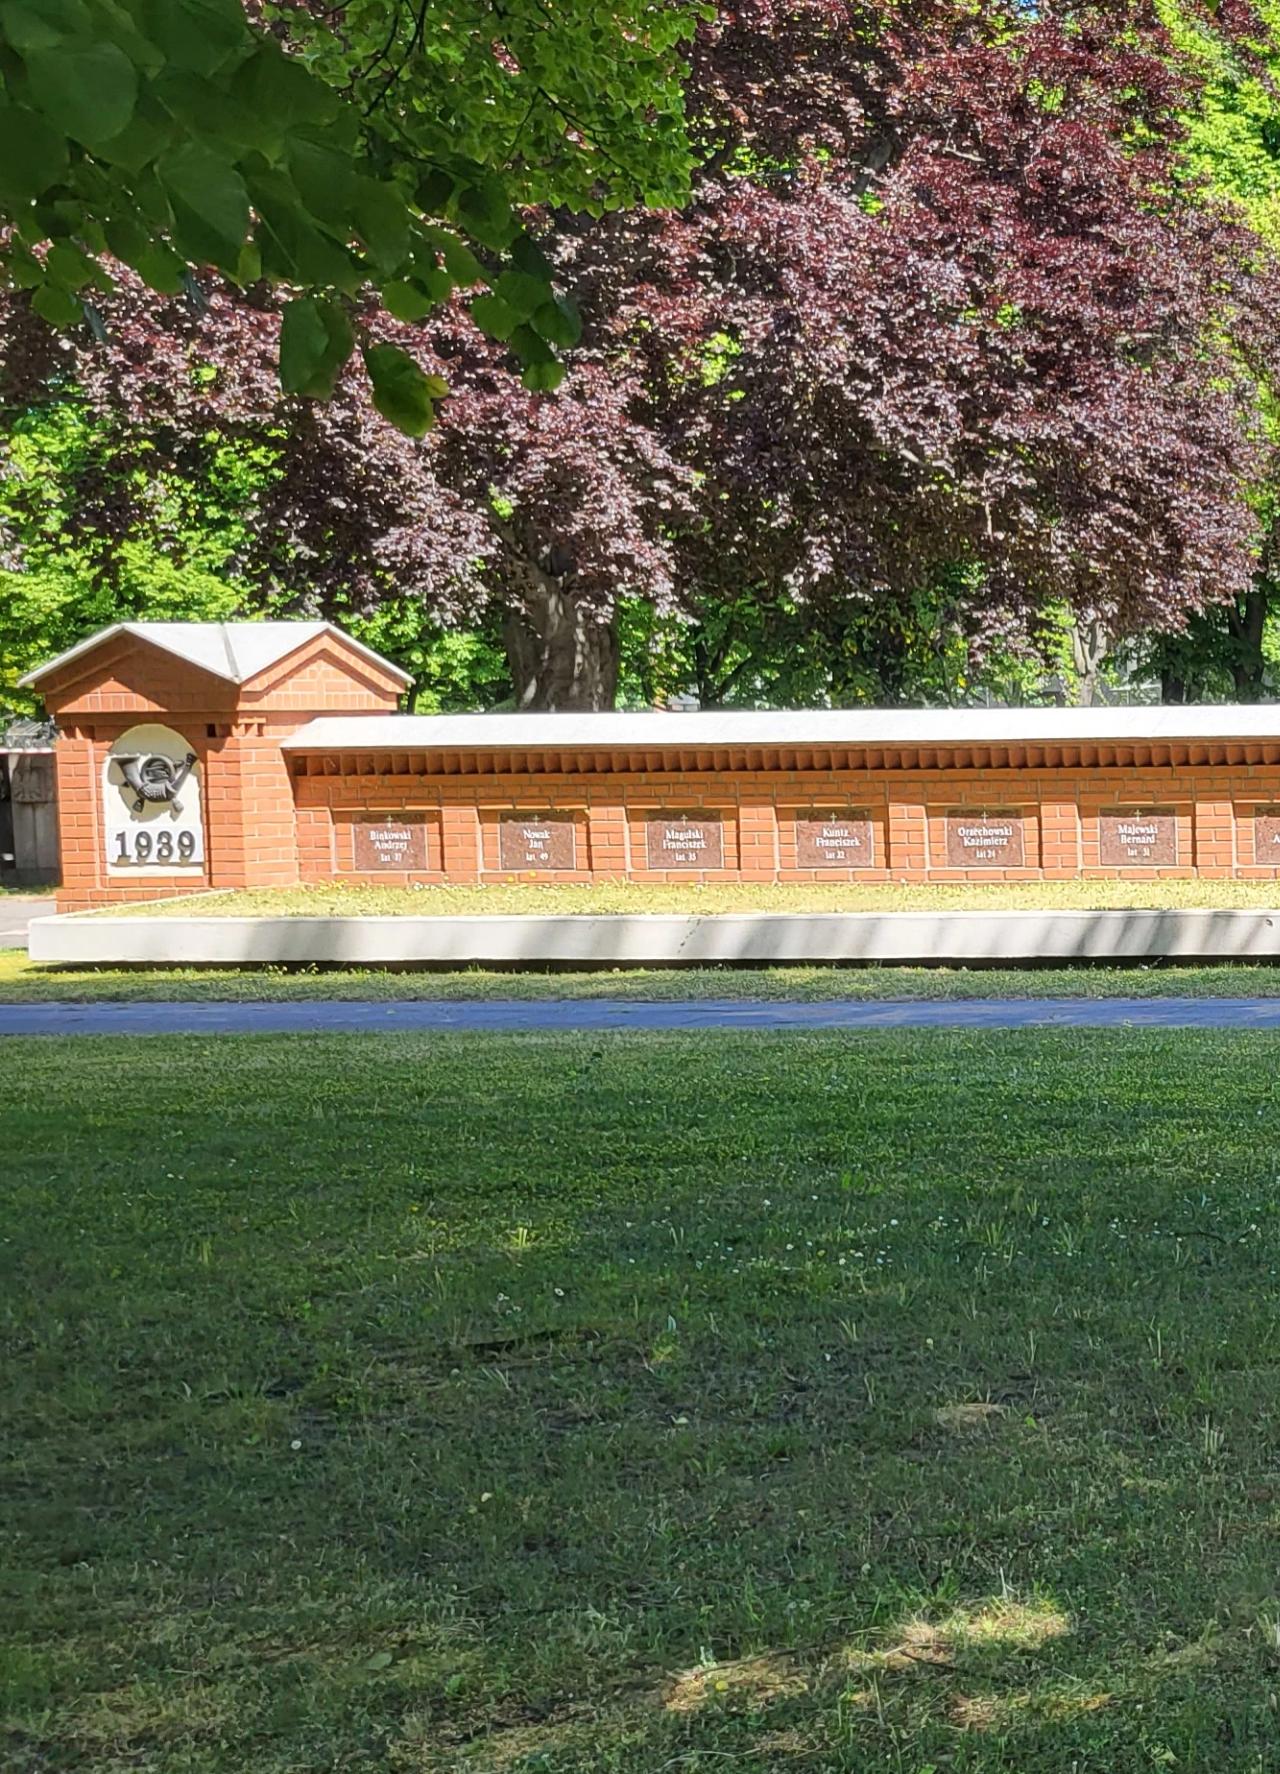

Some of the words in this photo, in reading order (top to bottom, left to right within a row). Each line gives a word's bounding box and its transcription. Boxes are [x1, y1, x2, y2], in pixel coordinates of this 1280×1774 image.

[523, 829, 551, 839] Nowak
[958, 826, 1012, 836] Orzechowski
[1118, 824, 1158, 835] Majewski
[529, 839, 544, 849] Jan
[663, 839, 707, 849] Franciszek
[815, 837, 861, 847] Franciszek
[963, 837, 1008, 846] Kazimierz
[1121, 834, 1155, 844] Bernard
[115, 831, 196, 858] 1939
